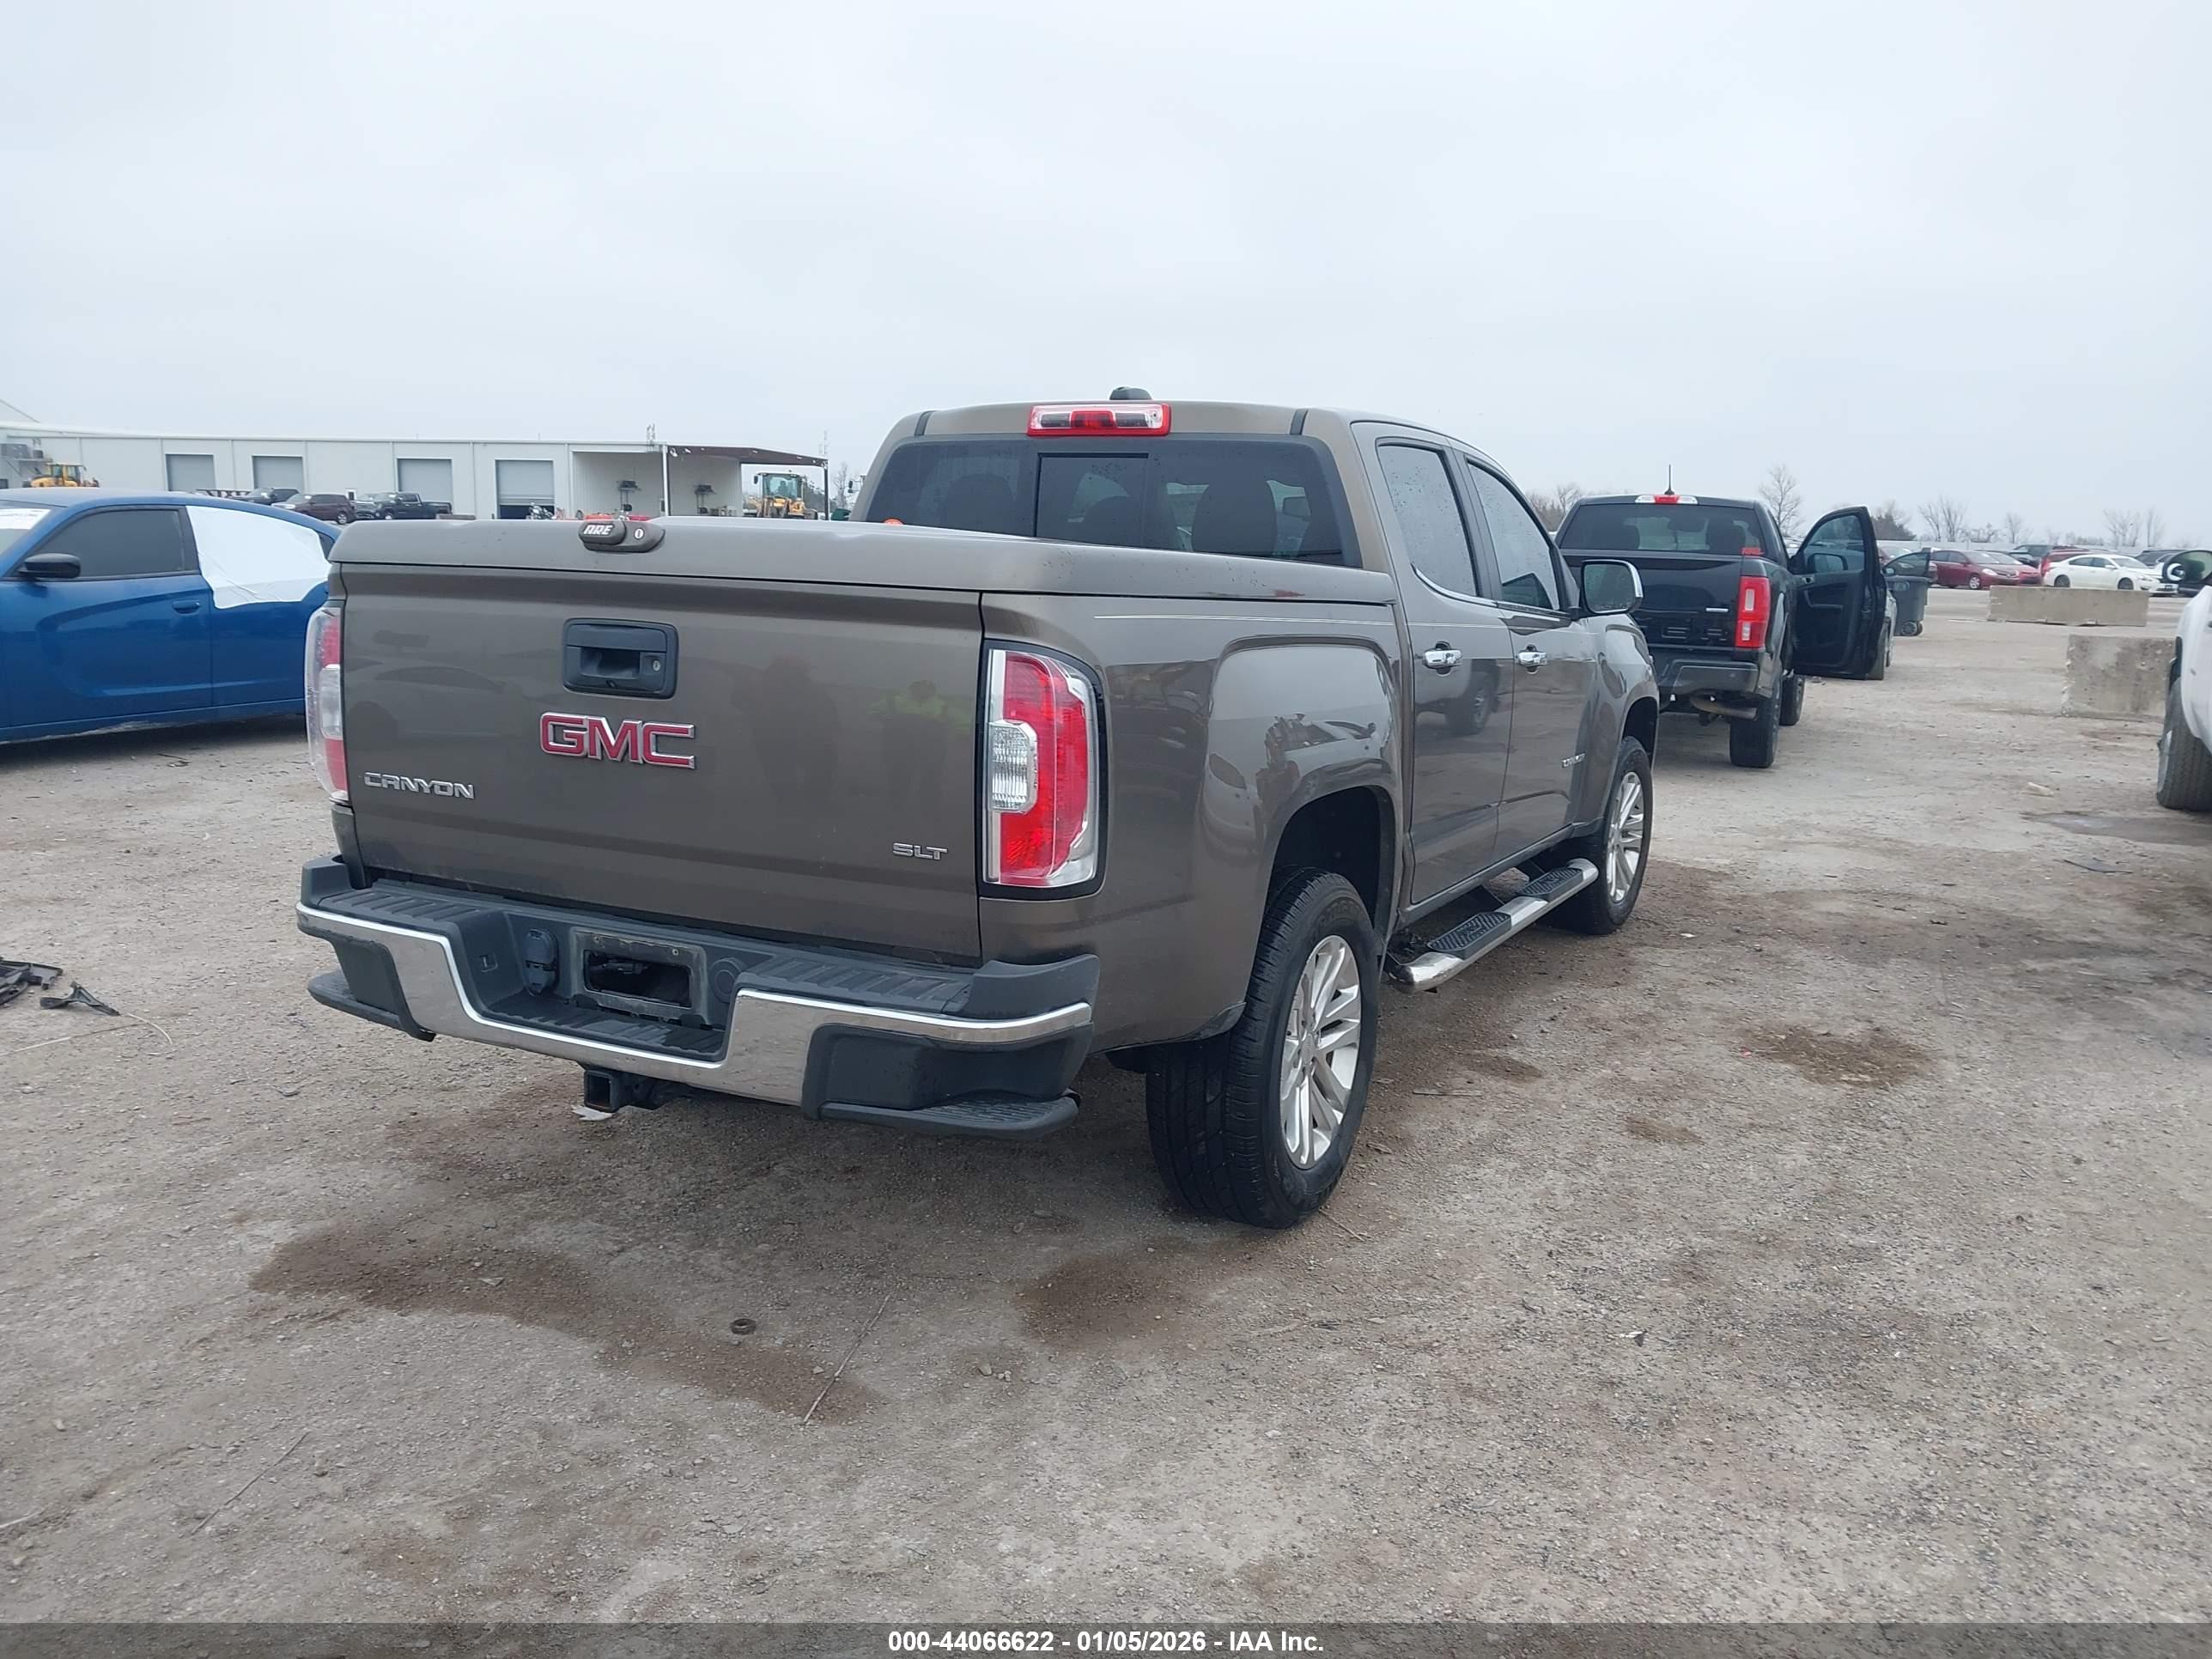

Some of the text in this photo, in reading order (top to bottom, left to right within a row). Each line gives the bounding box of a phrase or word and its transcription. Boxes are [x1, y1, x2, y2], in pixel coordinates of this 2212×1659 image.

[583, 524, 614, 536] ARE
[540, 712, 696, 769] GMC
[364, 772, 474, 799] CANYON
[893, 842, 947, 860] SLT
